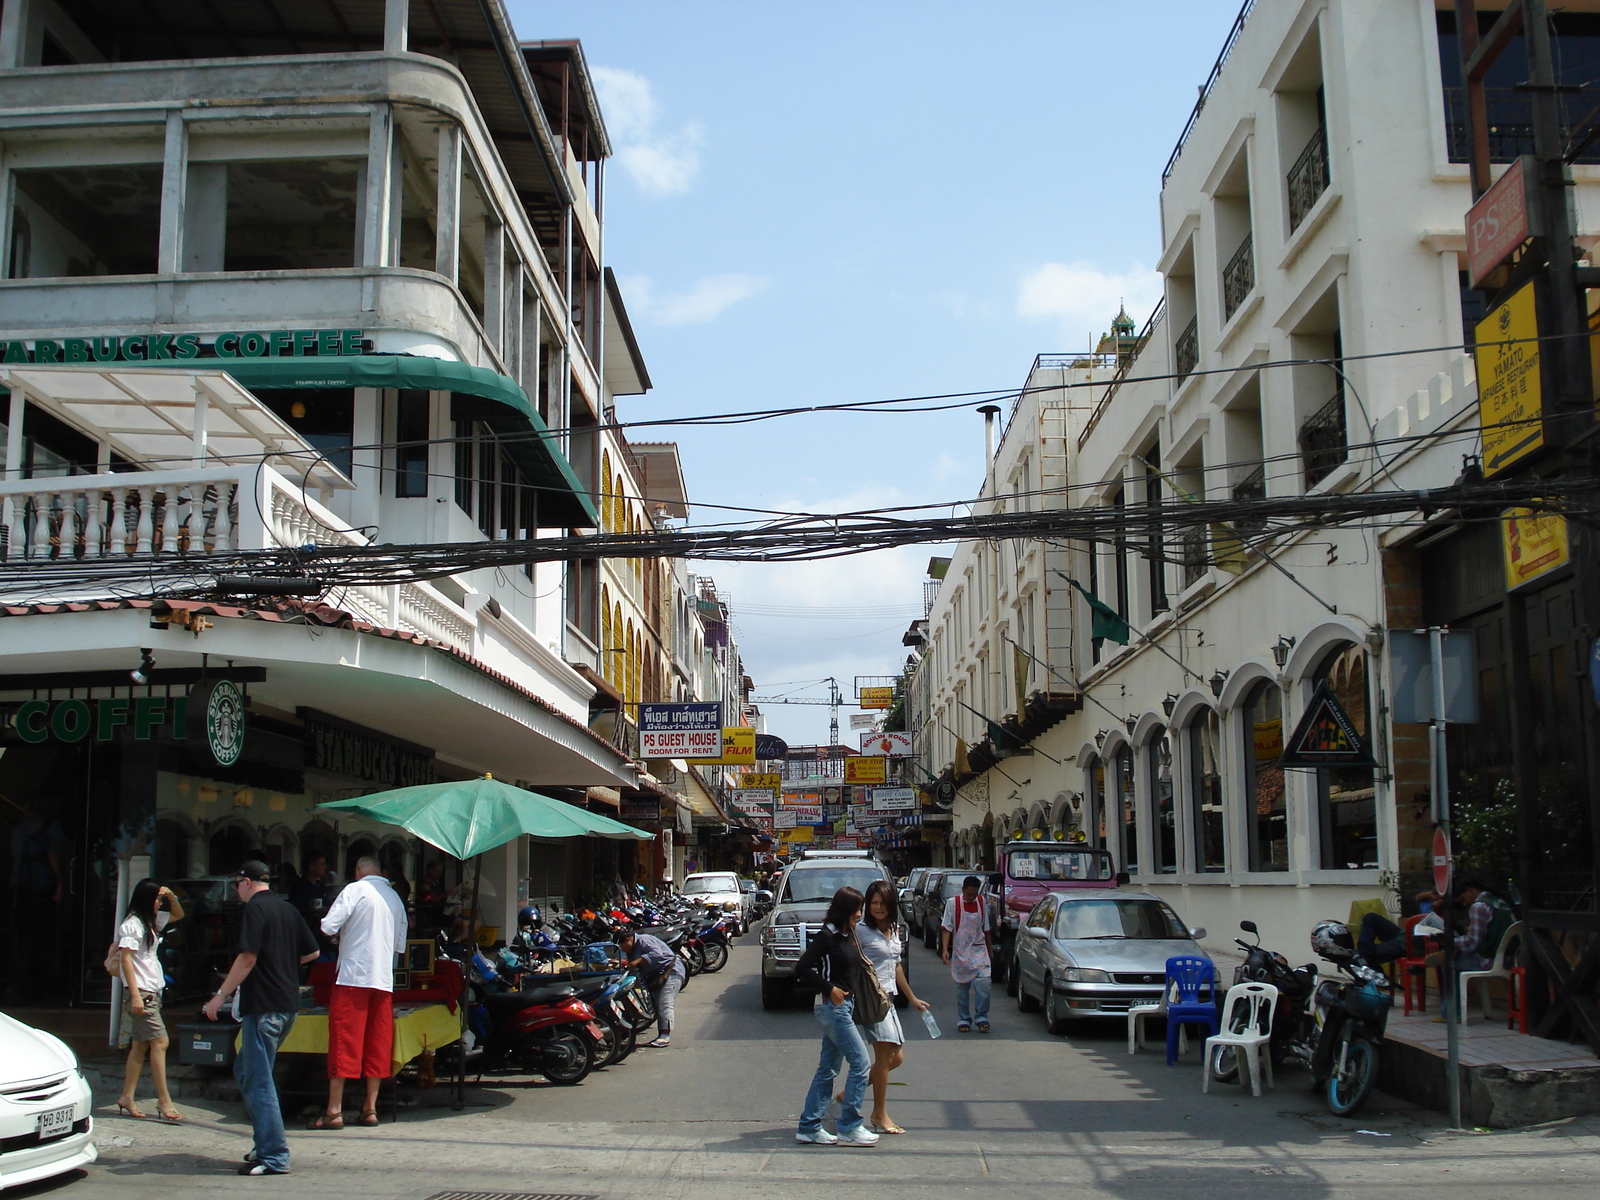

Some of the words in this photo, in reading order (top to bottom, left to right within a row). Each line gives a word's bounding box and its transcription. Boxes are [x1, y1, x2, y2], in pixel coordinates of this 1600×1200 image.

[1472, 204, 1500, 256] PS
[214, 329, 364, 358] COFFEE
[1481, 377, 1505, 402] JAPANESE
[1507, 352, 1539, 385] RESTAURANT
[1493, 346, 1523, 379] YAMATO
[209, 684, 242, 720] STARBUCKS
[1308, 718, 1348, 750] PIZZA
[1328, 699, 1361, 748] neapolitan
[213, 738, 238, 761] COFFEE
[644, 734, 655, 747] PS
[658, 733, 686, 746] GUEST
[688, 732, 717, 746] HOUSE
[726, 747, 752, 755] FILM
[863, 734, 886, 749] MOULIN
[888, 733, 911, 747] ROUGE
[316, 730, 396, 786] STARBUCKS
[752, 804, 772, 813] FILM
[56, 1108, 73, 1124] 9313
